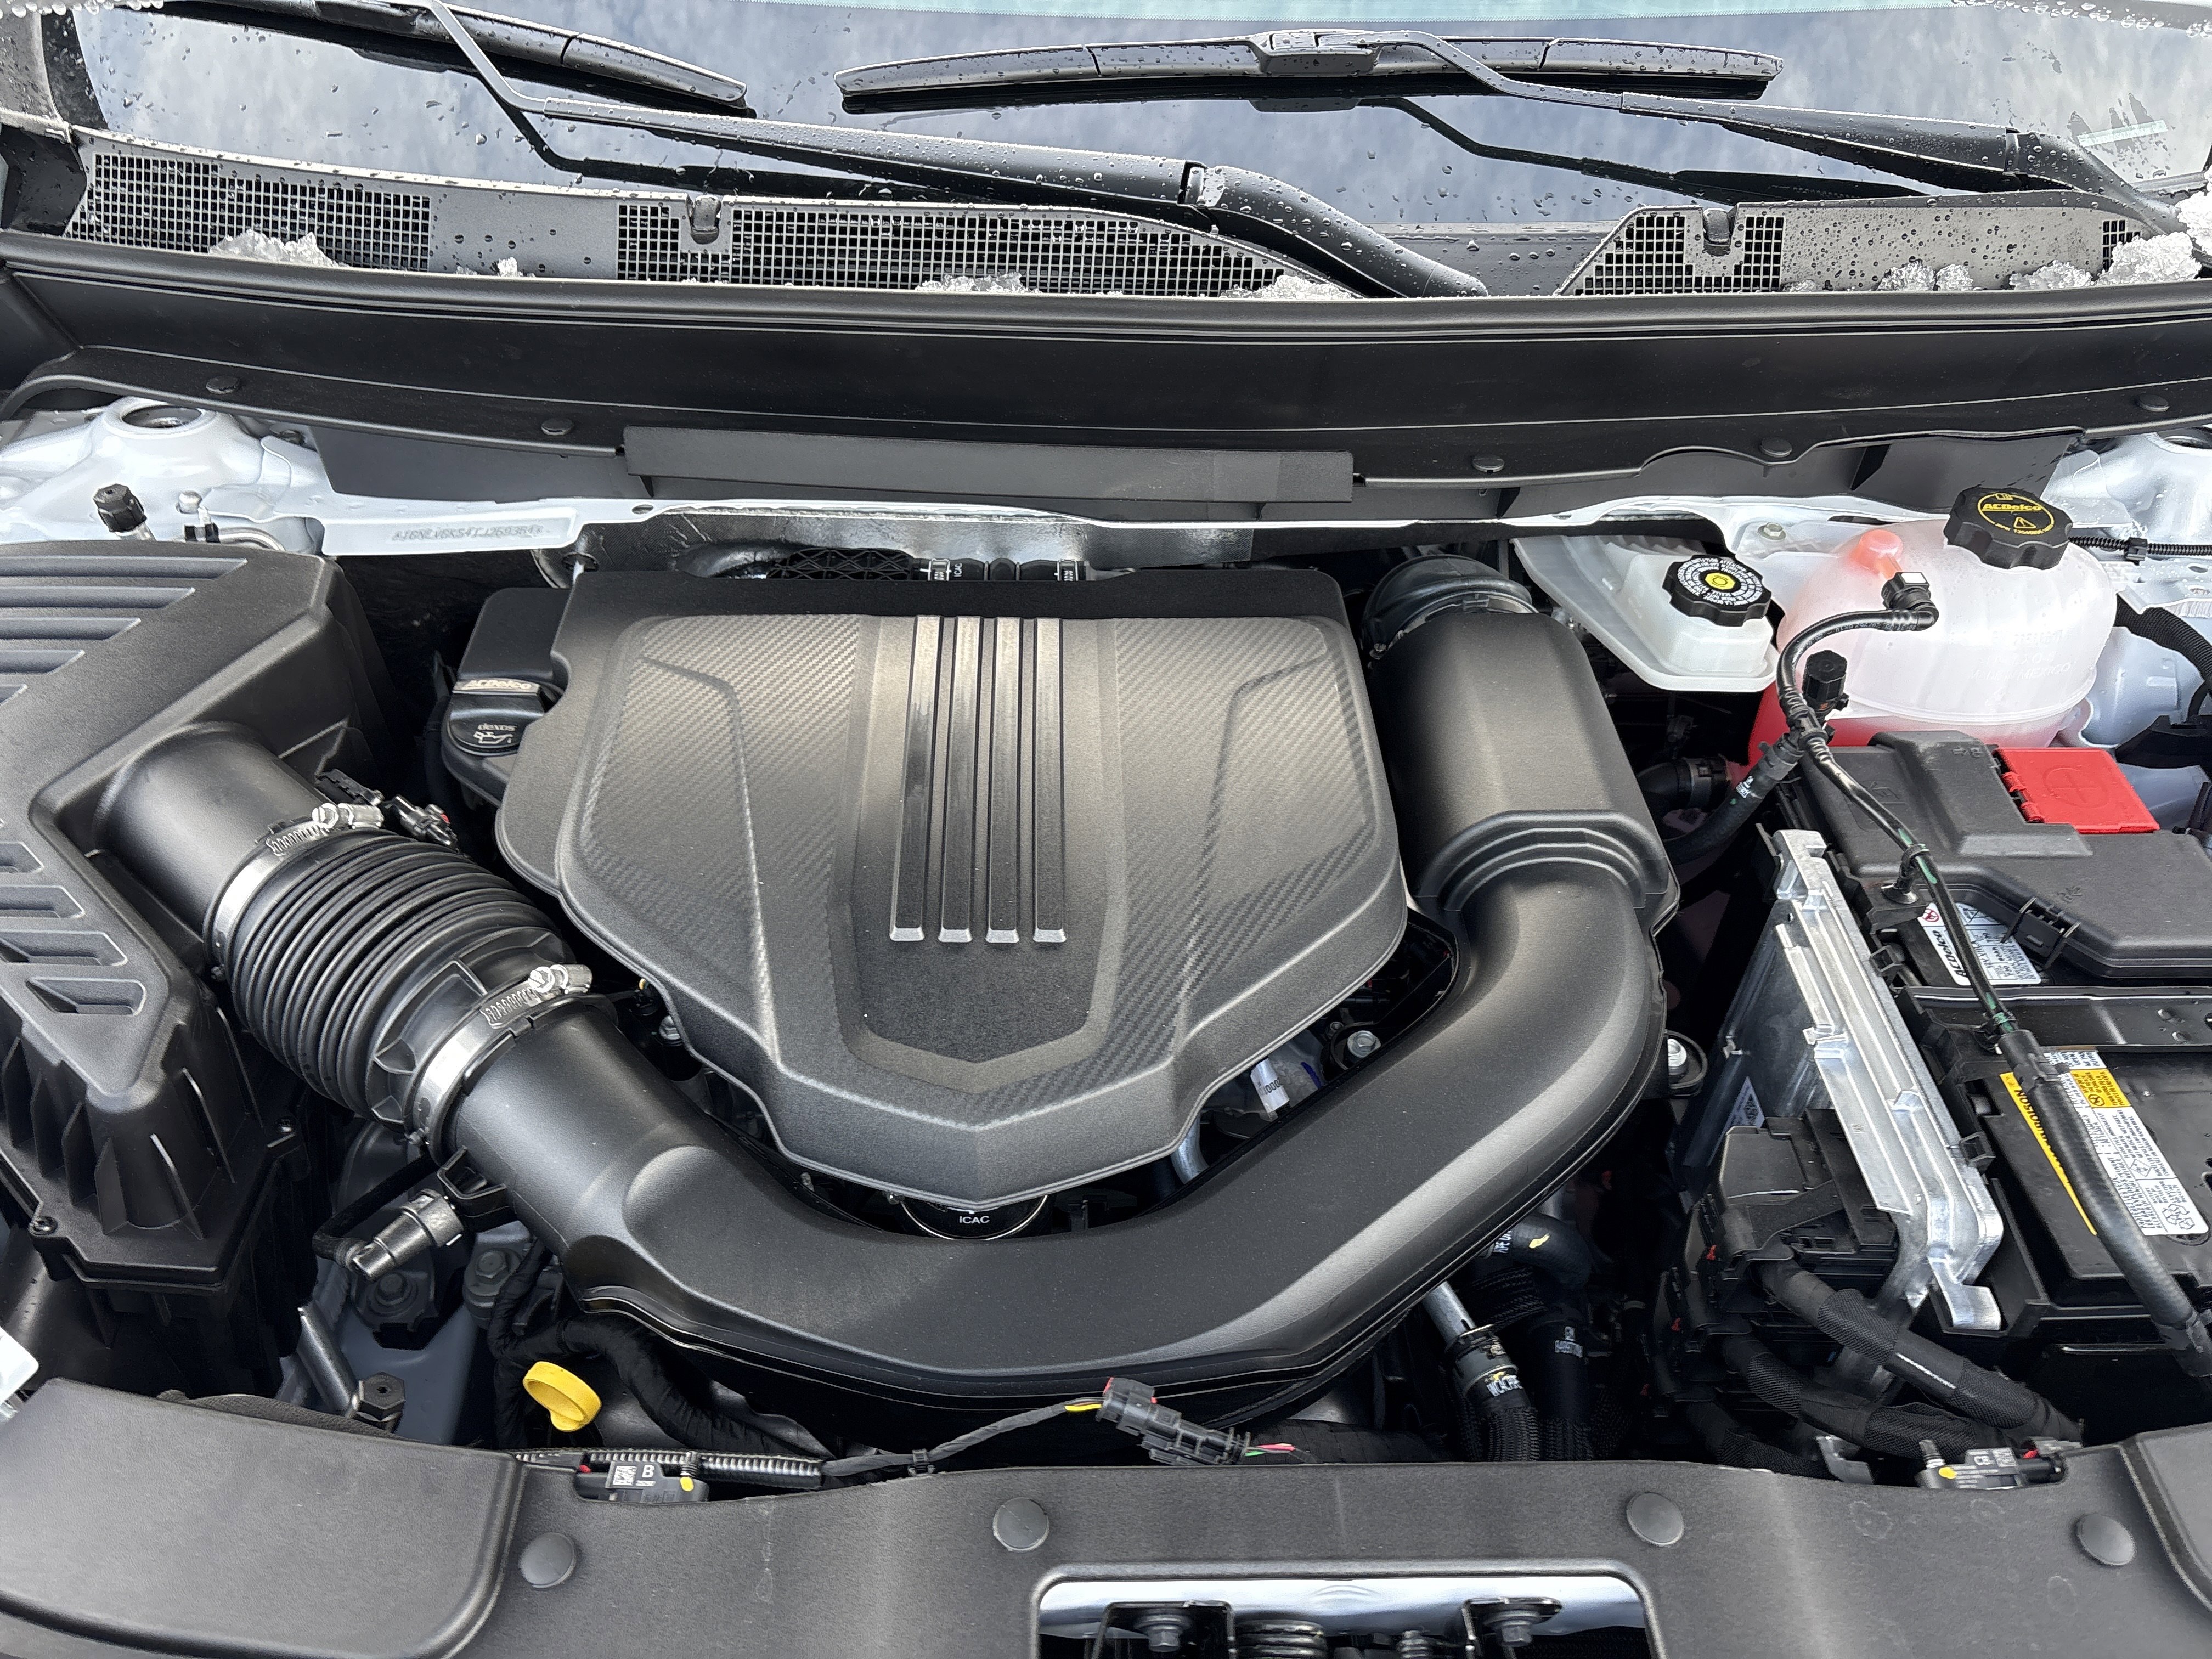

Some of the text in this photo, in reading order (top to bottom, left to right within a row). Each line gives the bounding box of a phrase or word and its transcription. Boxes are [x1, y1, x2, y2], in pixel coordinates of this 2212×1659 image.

[953, 563, 963, 577] ICAC
[477, 722, 517, 731] dexos
[959, 1216, 990, 1224] ICAC
[642, 1464, 654, 1478] B
